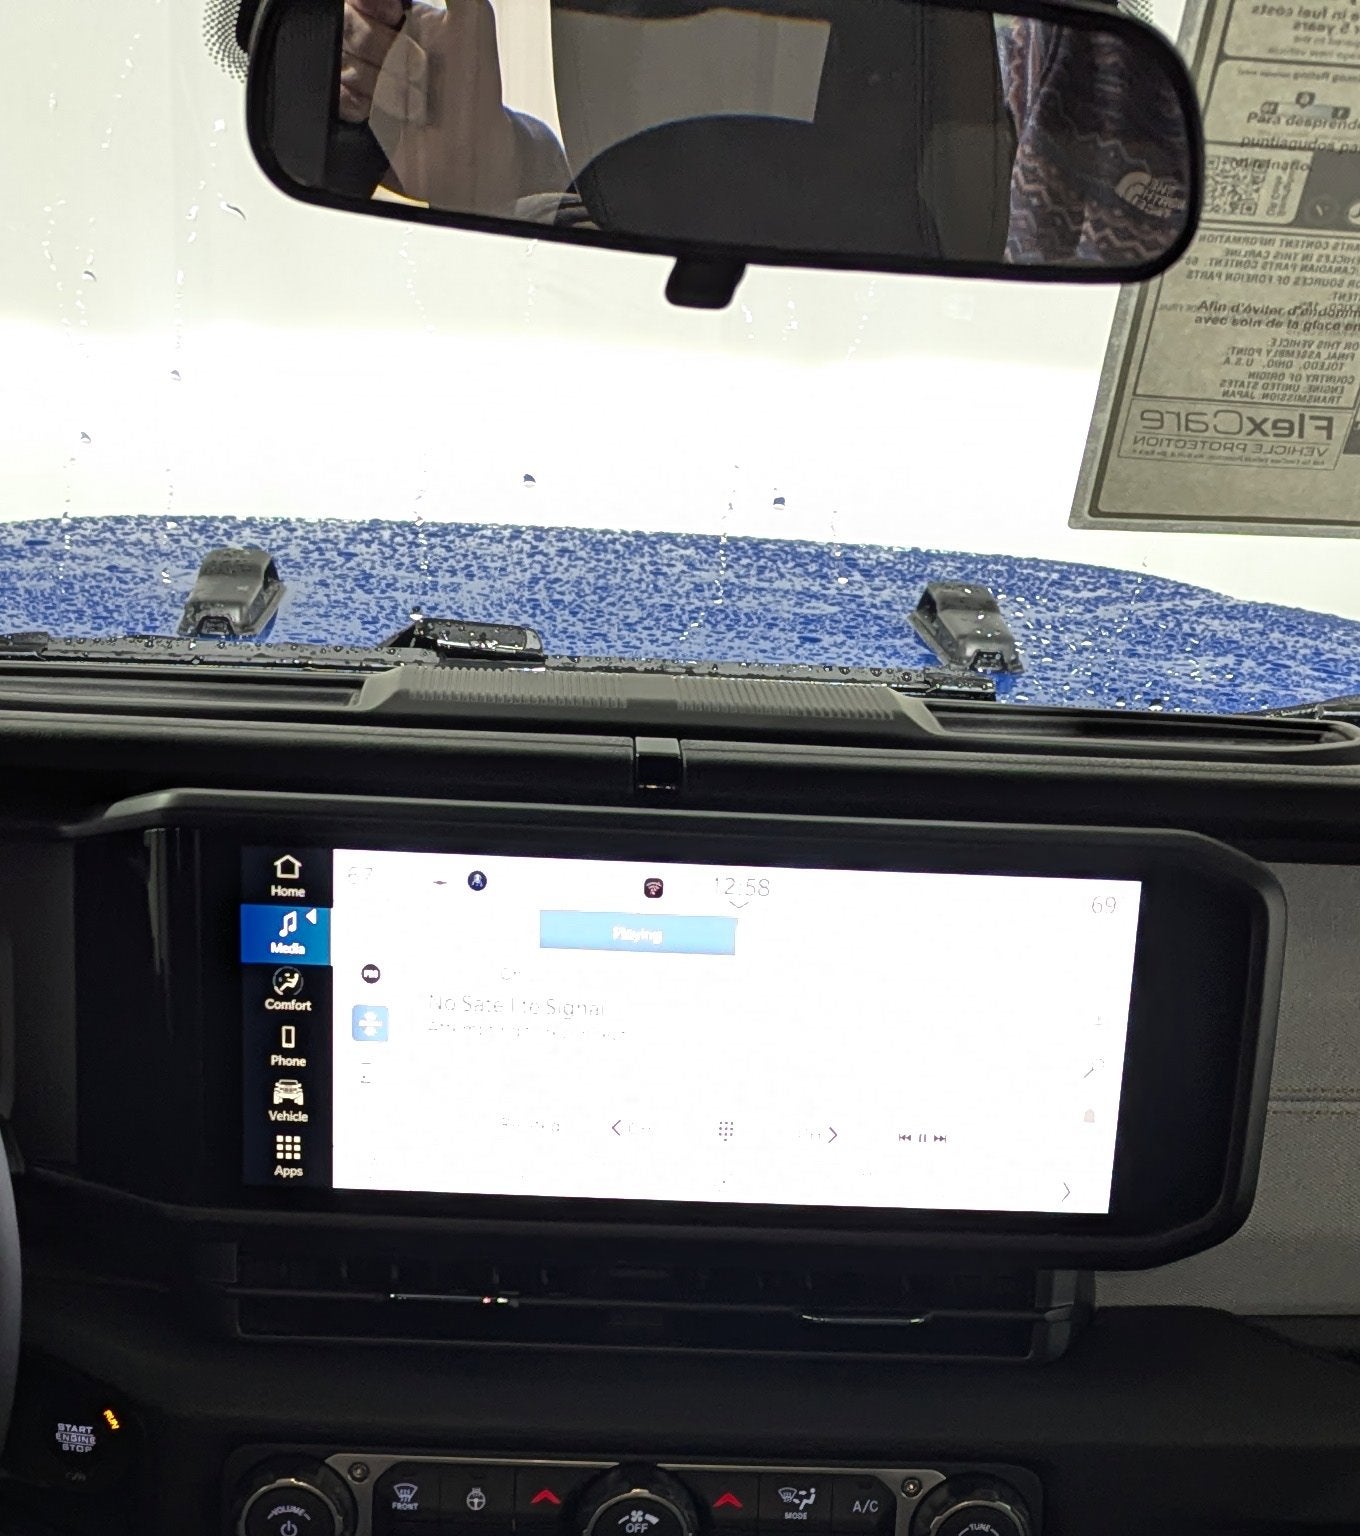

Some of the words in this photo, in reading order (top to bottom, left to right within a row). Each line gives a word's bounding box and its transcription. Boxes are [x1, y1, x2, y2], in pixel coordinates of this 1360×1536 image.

[1247, 111, 1282, 125] Para
[1196, 300, 1228, 314] Afin
[271, 885, 305, 898] Home
[1091, 895, 1116, 914] 69
[271, 941, 305, 955] Media
[265, 999, 312, 1012] Comfort
[271, 1055, 307, 1067] Phone
[268, 1110, 308, 1123] Vehicle
[274, 1165, 303, 1178] Apps
[57, 1422, 93, 1434] START
[56, 1432, 96, 1446] ENGINE
[61, 1443, 93, 1453] STOP
[273, 1504, 306, 1517] VOLUME
[391, 1502, 419, 1511] FRONT
[853, 1500, 879, 1513] A/C
[784, 1511, 808, 1520] MODE
[625, 1522, 649, 1534] OFF
[968, 1523, 992, 1533] TUNE
